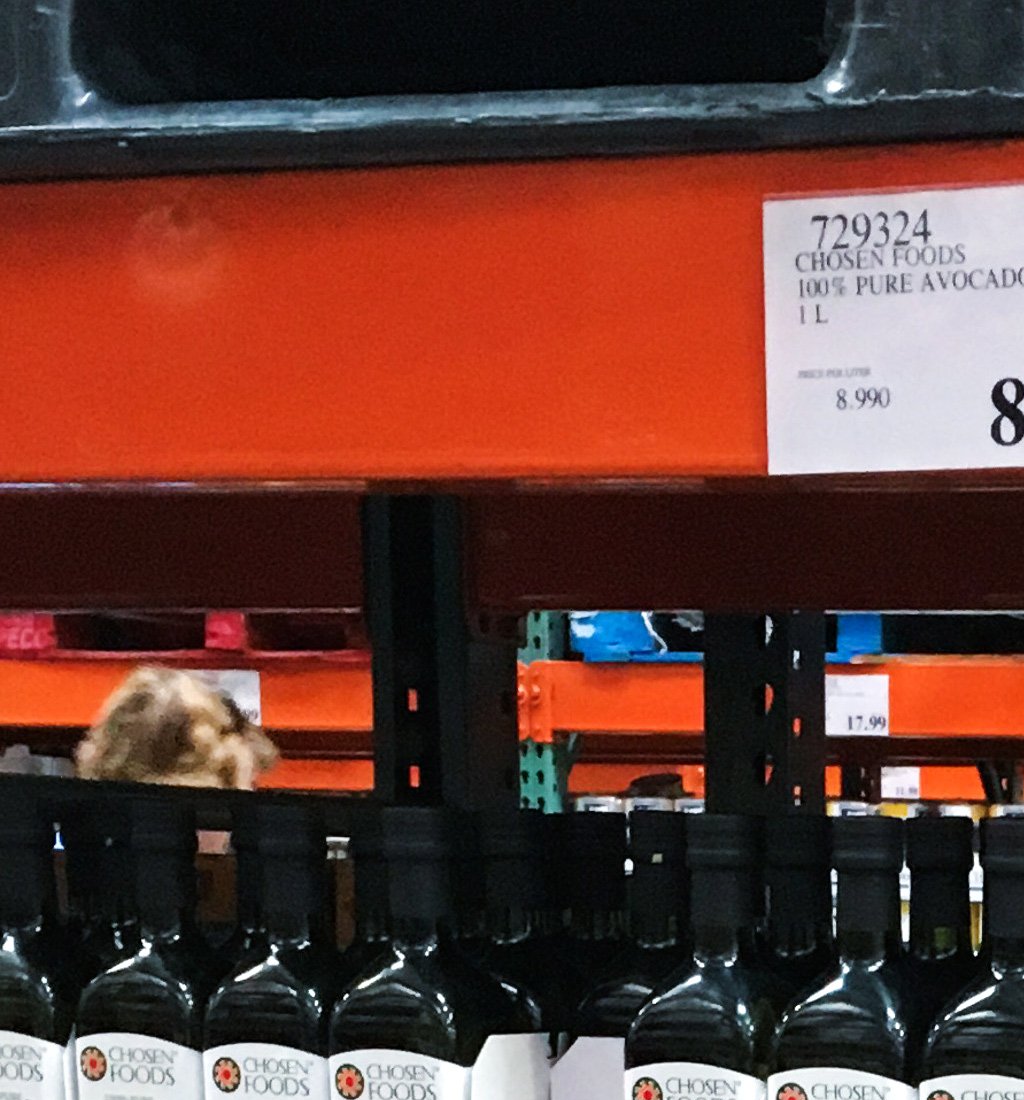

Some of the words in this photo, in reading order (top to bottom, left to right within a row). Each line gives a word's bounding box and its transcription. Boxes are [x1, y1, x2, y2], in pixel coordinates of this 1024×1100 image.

[812, 209, 931, 250] 729324
[795, 250, 883, 272] CHOSEN
[892, 244, 965, 267] FOODS
[799, 277, 845, 298] 100%
[856, 273, 912, 295] PURE
[800, 305, 805, 324] 1
[816, 304, 827, 323] L
[836, 388, 890, 410] 8.990
[848, 715, 886, 730] 17.99
[110, 1063, 175, 1086] FOODS
